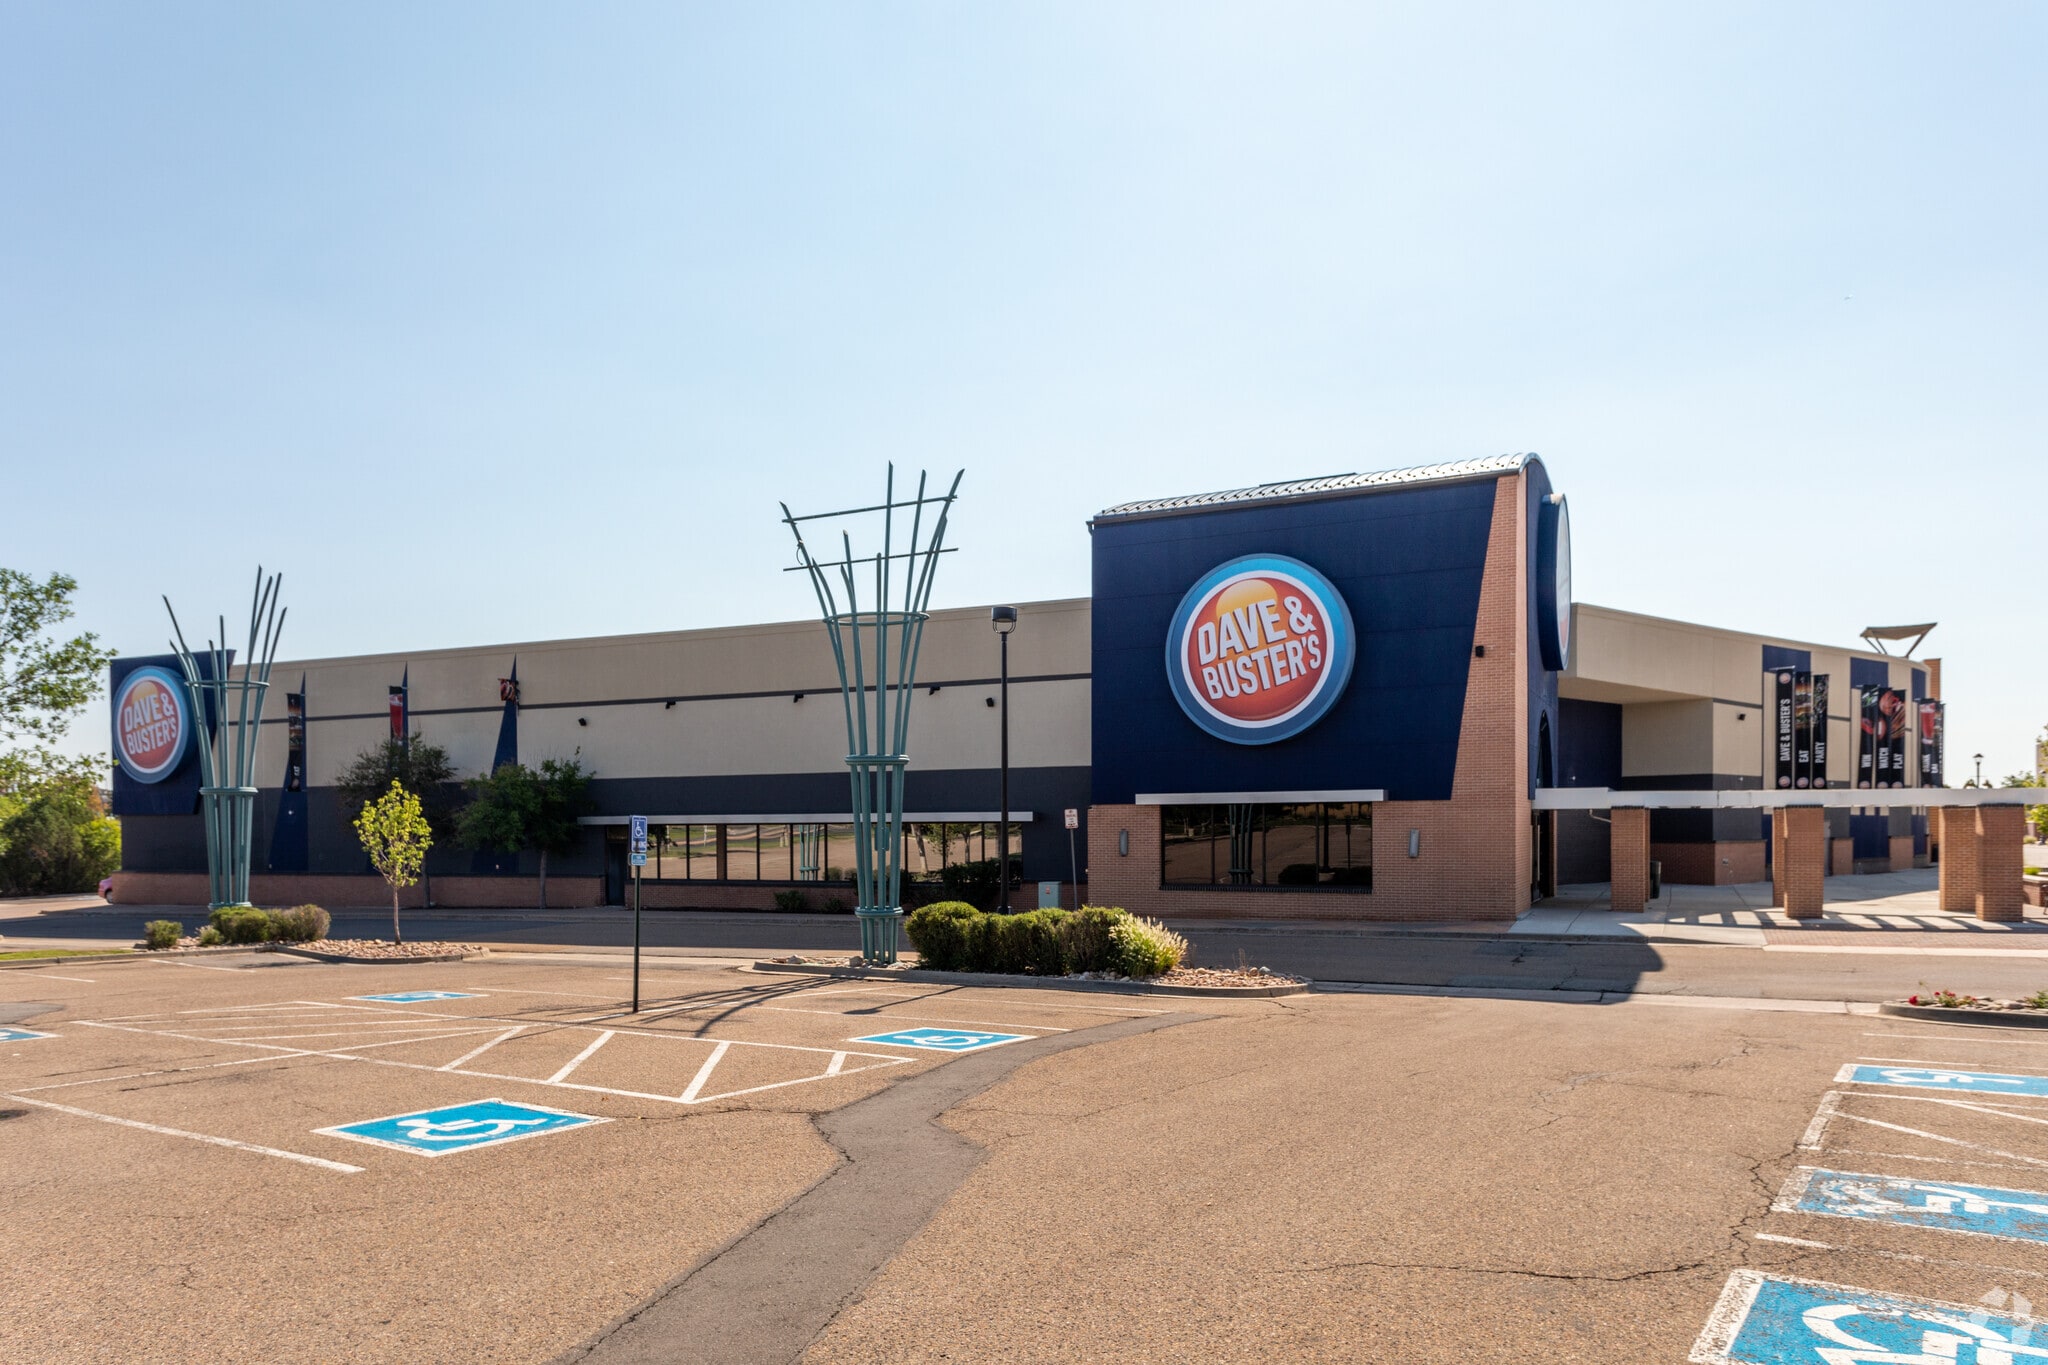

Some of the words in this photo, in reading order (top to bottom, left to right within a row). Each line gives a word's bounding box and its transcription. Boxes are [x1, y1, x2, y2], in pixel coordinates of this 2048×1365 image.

[1198, 599, 1287, 666] DAVE
[1283, 595, 1317, 635] &
[1202, 634, 1322, 700] BUSTER'S
[124, 694, 162, 732] DAVE
[160, 692, 175, 717] &
[1780, 698, 1791, 734] BUSTER'S
[126, 717, 177, 754] BUSTER'S
[1780, 734, 1791, 742] &
[1780, 742, 1791, 761] DAVE
[1798, 749, 1809, 763] EAT
[1814, 741, 1825, 764] PARTY
[1861, 753, 1872, 768] WIN
[1878, 747, 1889, 769] WATCH
[1892, 753, 1903, 769] PLAY
